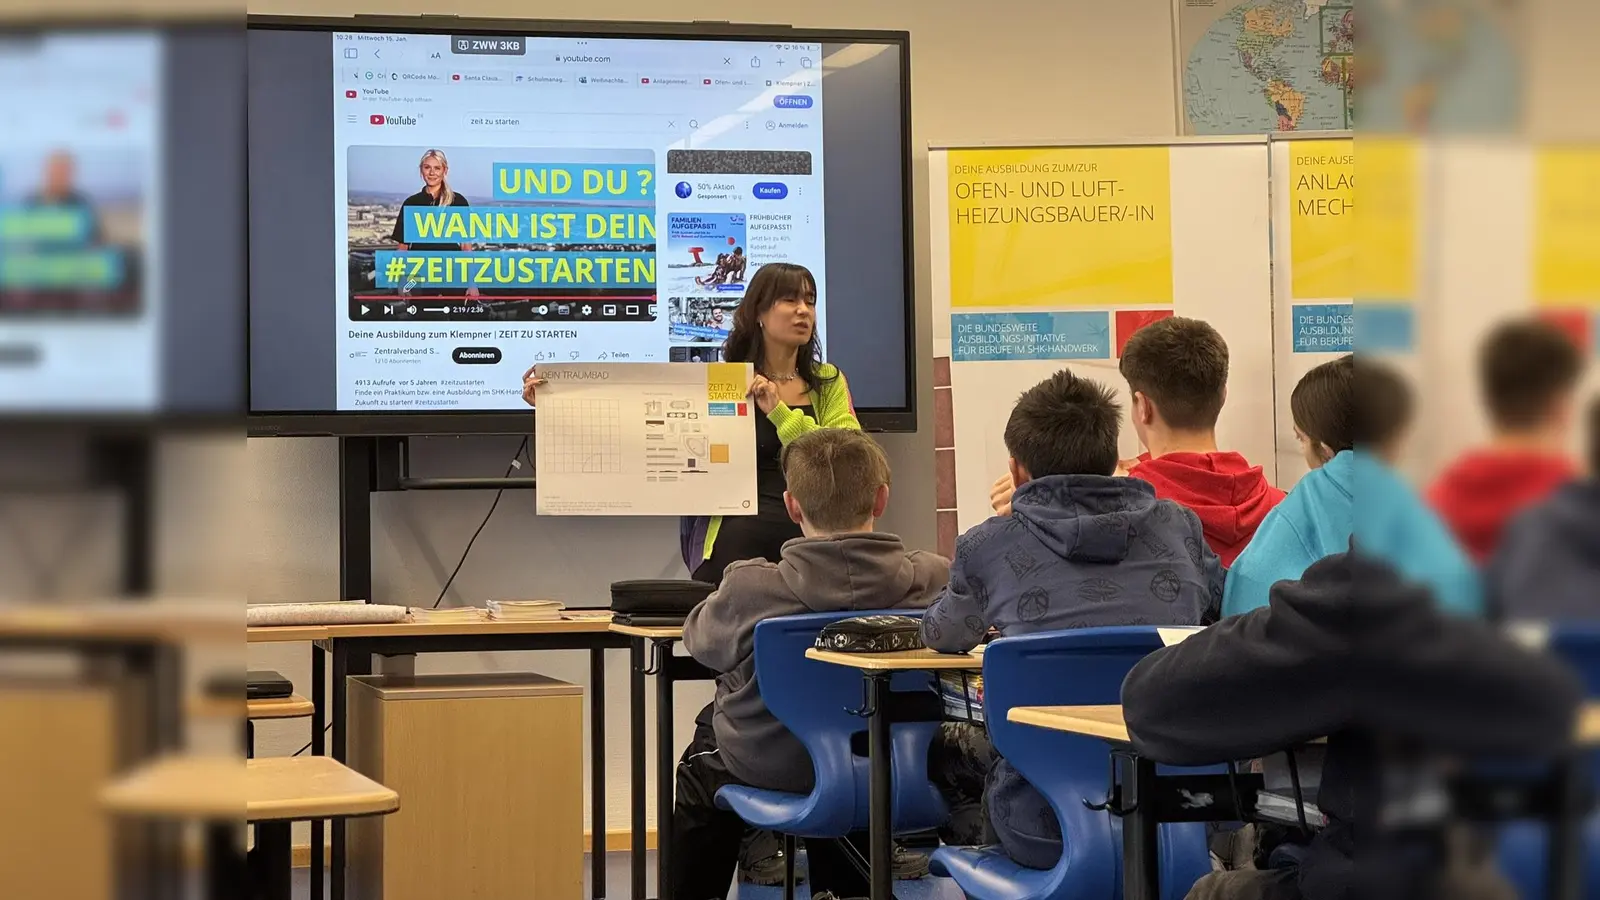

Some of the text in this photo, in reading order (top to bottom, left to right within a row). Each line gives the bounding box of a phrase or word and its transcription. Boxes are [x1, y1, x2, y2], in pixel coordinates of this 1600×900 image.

[472, 40, 520, 50] ZWW 3KB
[385, 116, 417, 125] YouTube
[470, 117, 483, 125] zeit
[495, 118, 520, 126] starten
[1296, 156, 1326, 165] DEINE
[955, 163, 1098, 174] DEINE AUSBILDUNG ZUM/ZUR
[499, 168, 572, 195] UND
[583, 169, 628, 195] DU
[955, 180, 1124, 199] OFEN- UND LUFT-
[749, 213, 792, 221] FRÜHBUCHER
[956, 205, 1155, 224] HEIZUNGSBAUER/-IN
[413, 212, 657, 239] WANN IST DEIN
[385, 256, 656, 284] #ZEITZUSTARTEN
[1300, 316, 1313, 324] DIE
[958, 323, 1038, 333] DIE BUNDESWEITE
[348, 331, 374, 339] Deine
[376, 331, 426, 340] Ausbildung
[450, 331, 492, 341] Klempner
[499, 331, 519, 339] ZEIT
[521, 331, 534, 339] ZU
[535, 331, 578, 339] STARTEN
[958, 334, 1066, 344] AUSBILDUNGS-INITIATIVE
[1320, 336, 1353, 346] BERUFE
[958, 344, 1099, 355] FÜR BERUFE IM SHK-HANDWERK
[541, 371, 609, 380] DEIN TRAUMBAD
[708, 383, 737, 392] ZEIT ZU
[708, 391, 742, 400] STARTEN
